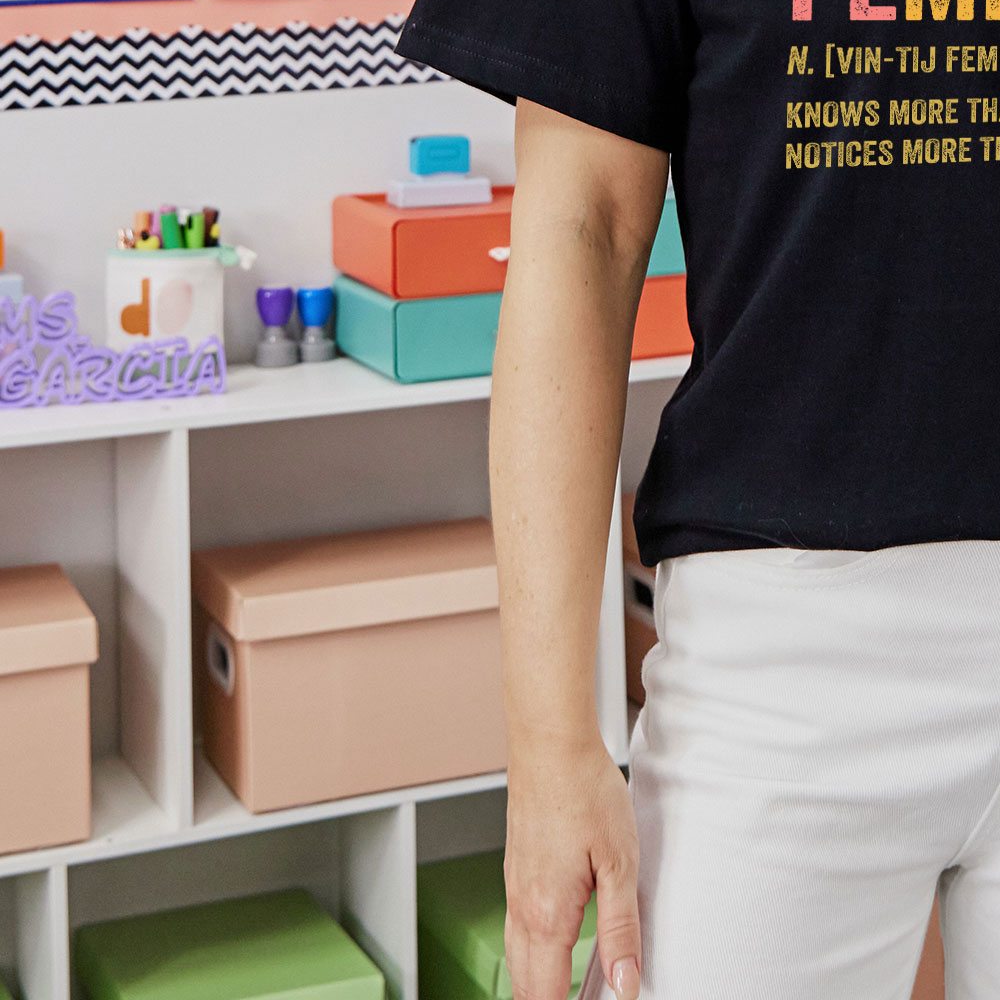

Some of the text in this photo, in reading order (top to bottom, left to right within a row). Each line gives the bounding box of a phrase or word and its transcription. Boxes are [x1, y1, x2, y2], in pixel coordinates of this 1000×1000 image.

[787, 45, 814, 75] N.
[825, 43, 936, 78] [VIN-TIJ
[787, 100, 879, 128] KNOWS
[890, 99, 958, 125] MORE
[786, 140, 893, 169] NOTICES
[903, 138, 972, 165] MORE
[0, 336, 227, 410] GARCIA
